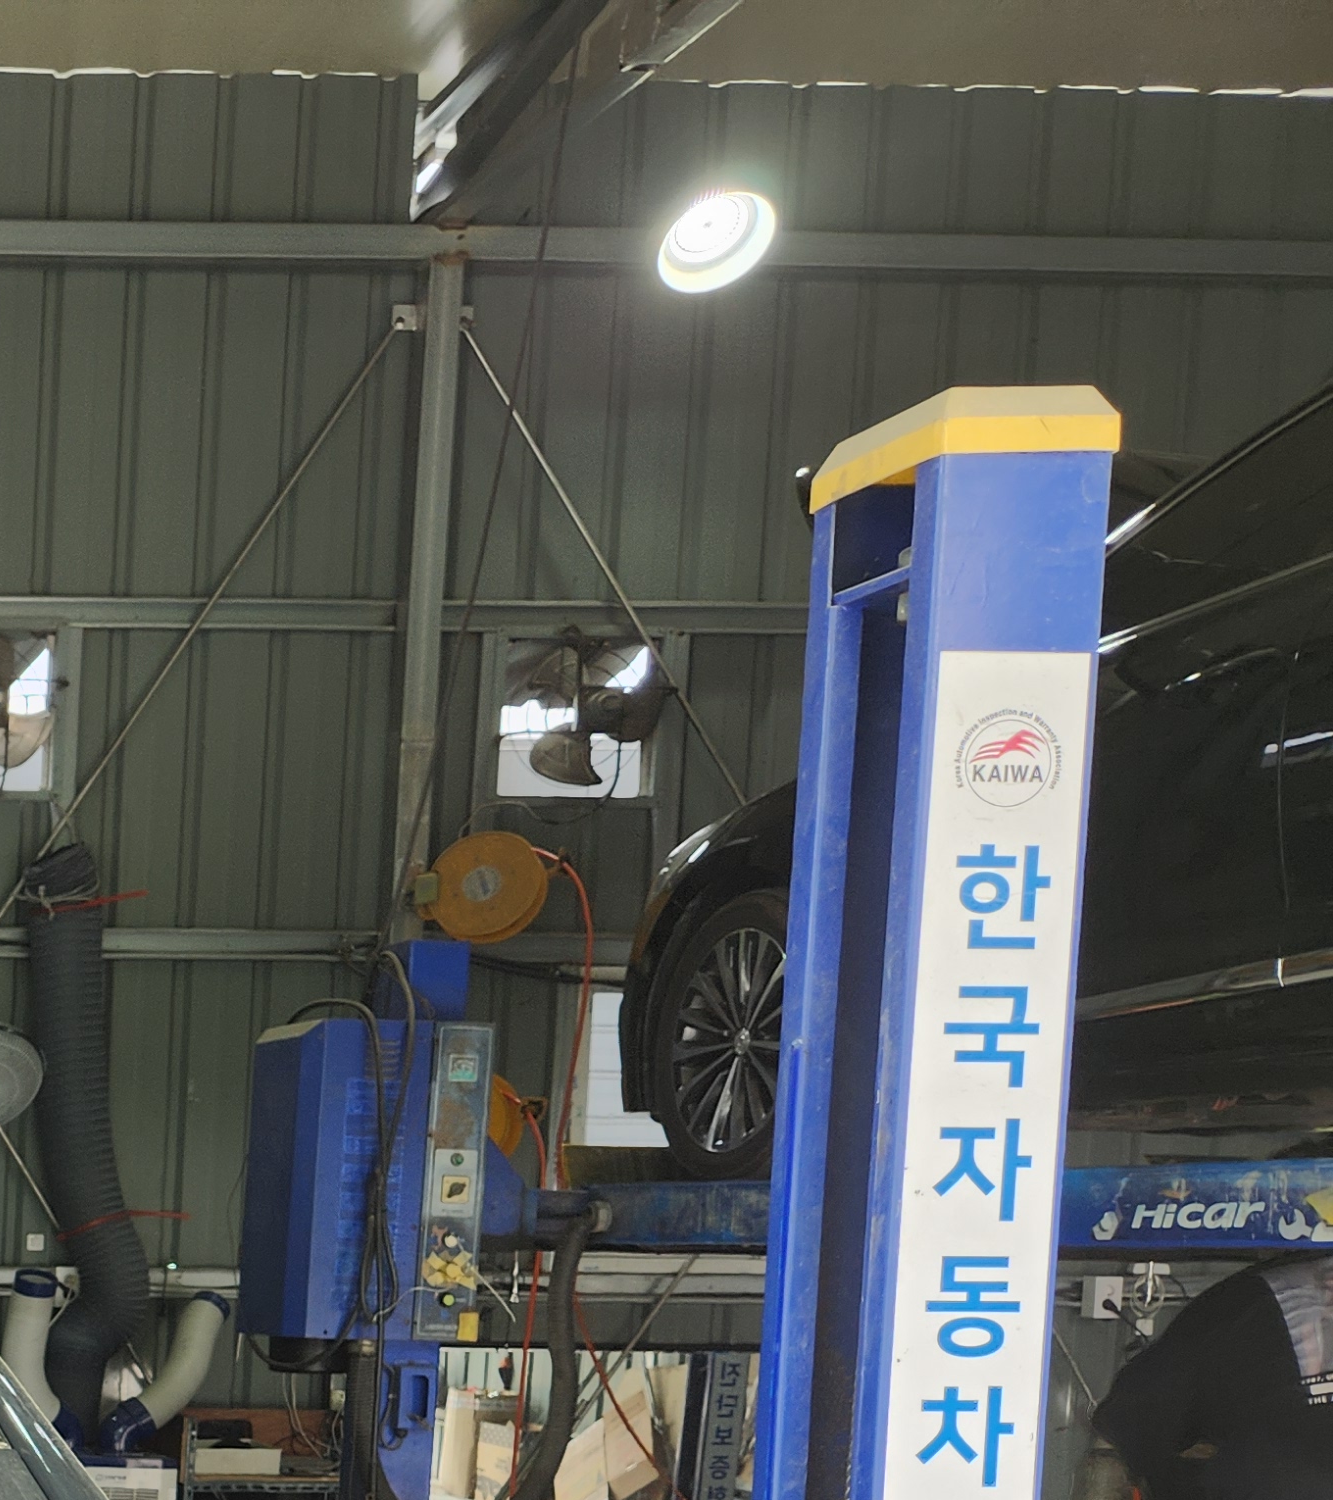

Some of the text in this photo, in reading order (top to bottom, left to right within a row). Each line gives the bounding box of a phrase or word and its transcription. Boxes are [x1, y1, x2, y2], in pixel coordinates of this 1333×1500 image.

[977, 708, 1018, 725] Inspection
[1019, 710, 1034, 719] and
[972, 764, 1044, 783] KAIWA
[1131, 1201, 1266, 1230] Hicar
